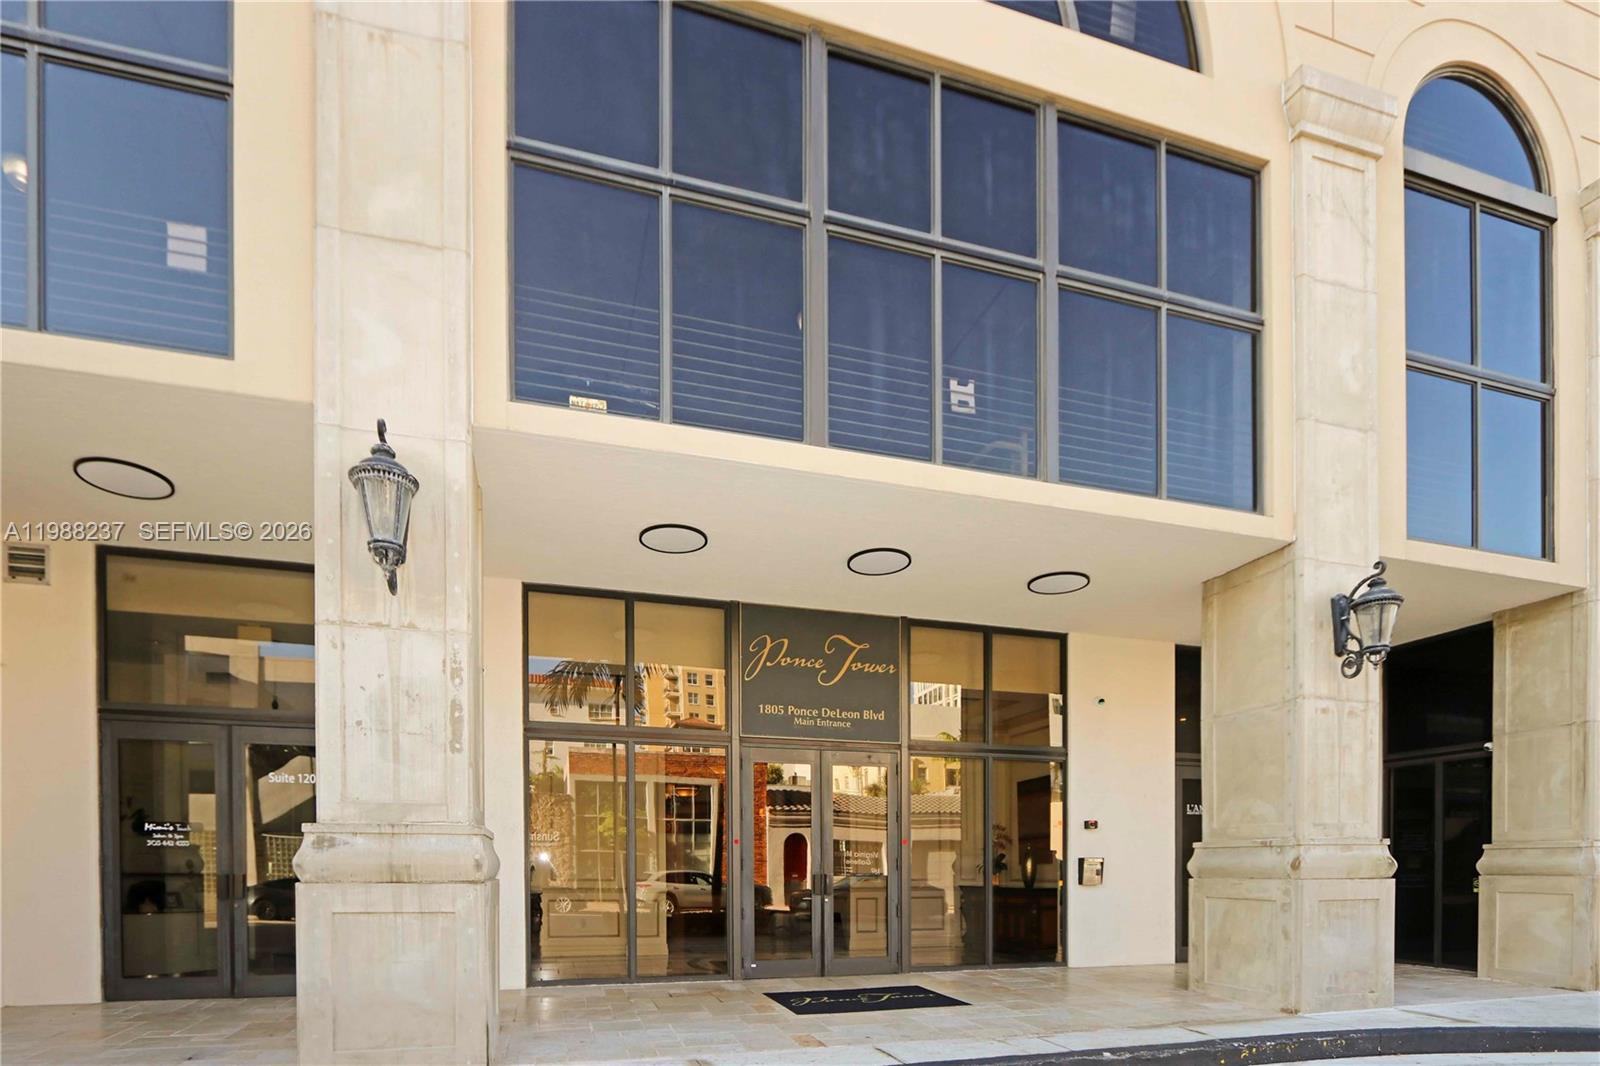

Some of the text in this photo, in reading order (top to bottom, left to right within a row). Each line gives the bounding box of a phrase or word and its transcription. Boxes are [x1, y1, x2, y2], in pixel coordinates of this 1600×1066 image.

[744, 634, 897, 686] Ponce Tower
[758, 704, 886, 721] 1805 Ponce DeLeon Blvd
[793, 717, 852, 728] Main Entrance
[268, 772, 316, 784] Suite 120
